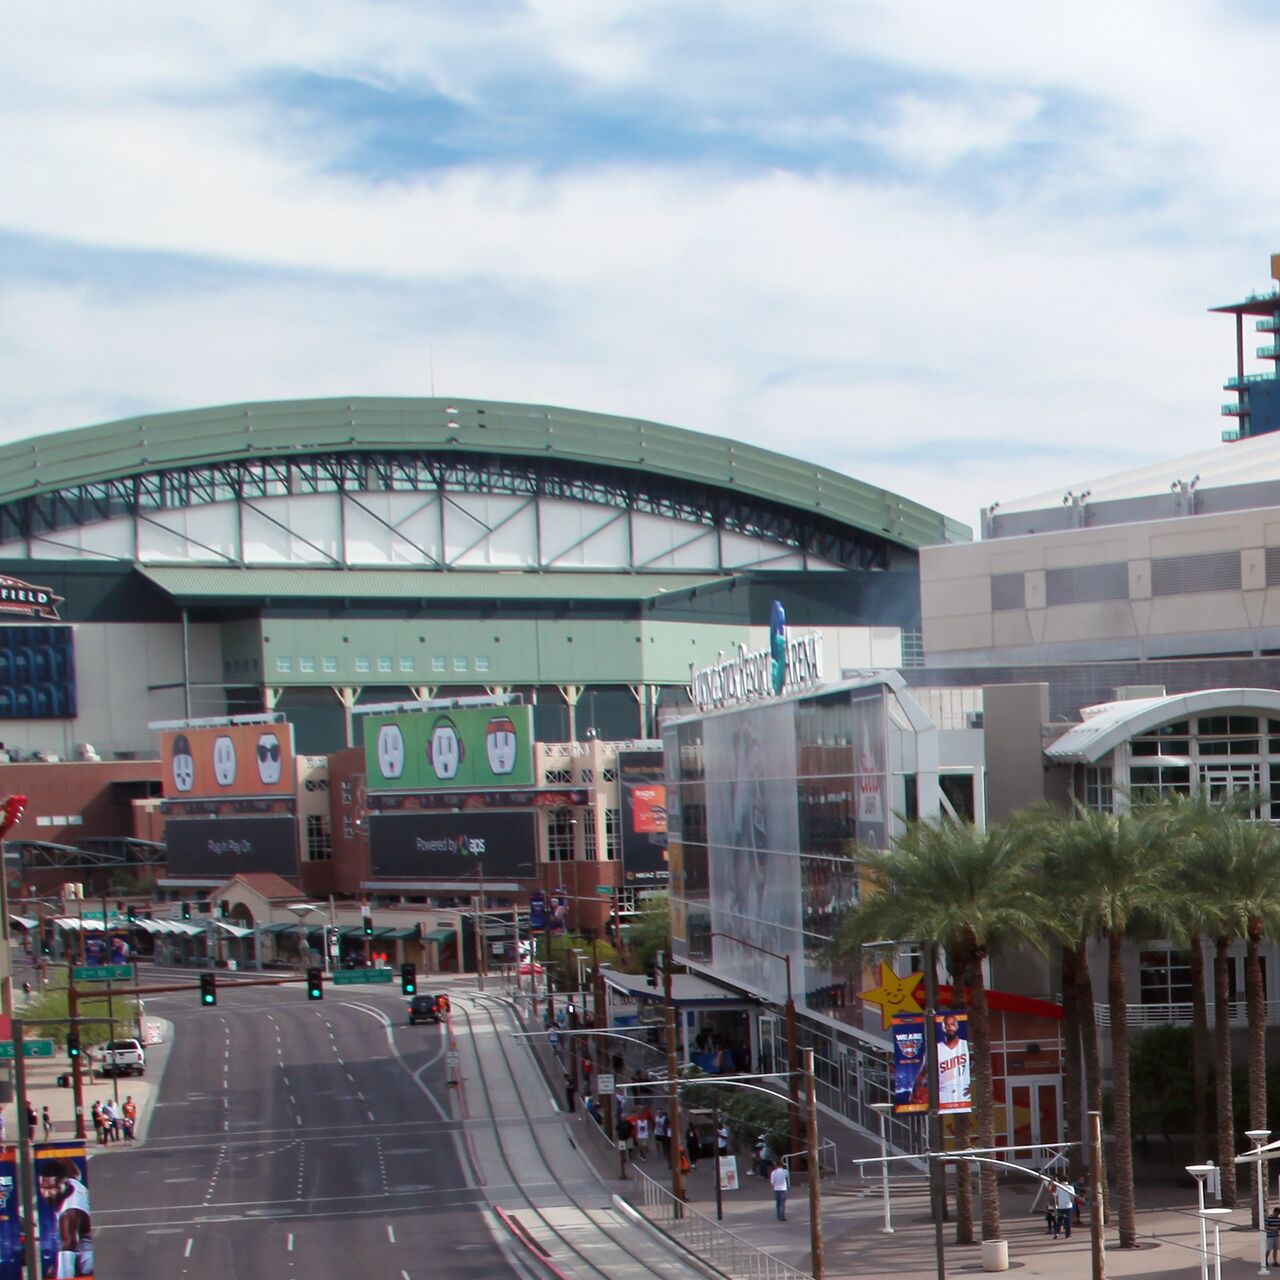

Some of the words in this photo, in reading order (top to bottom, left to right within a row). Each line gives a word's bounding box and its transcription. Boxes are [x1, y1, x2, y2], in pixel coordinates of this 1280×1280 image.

[1, 588, 48, 603] FIELD
[416, 837, 447, 852] Powered
[449, 838, 458, 854] by
[469, 838, 485, 855] aps
